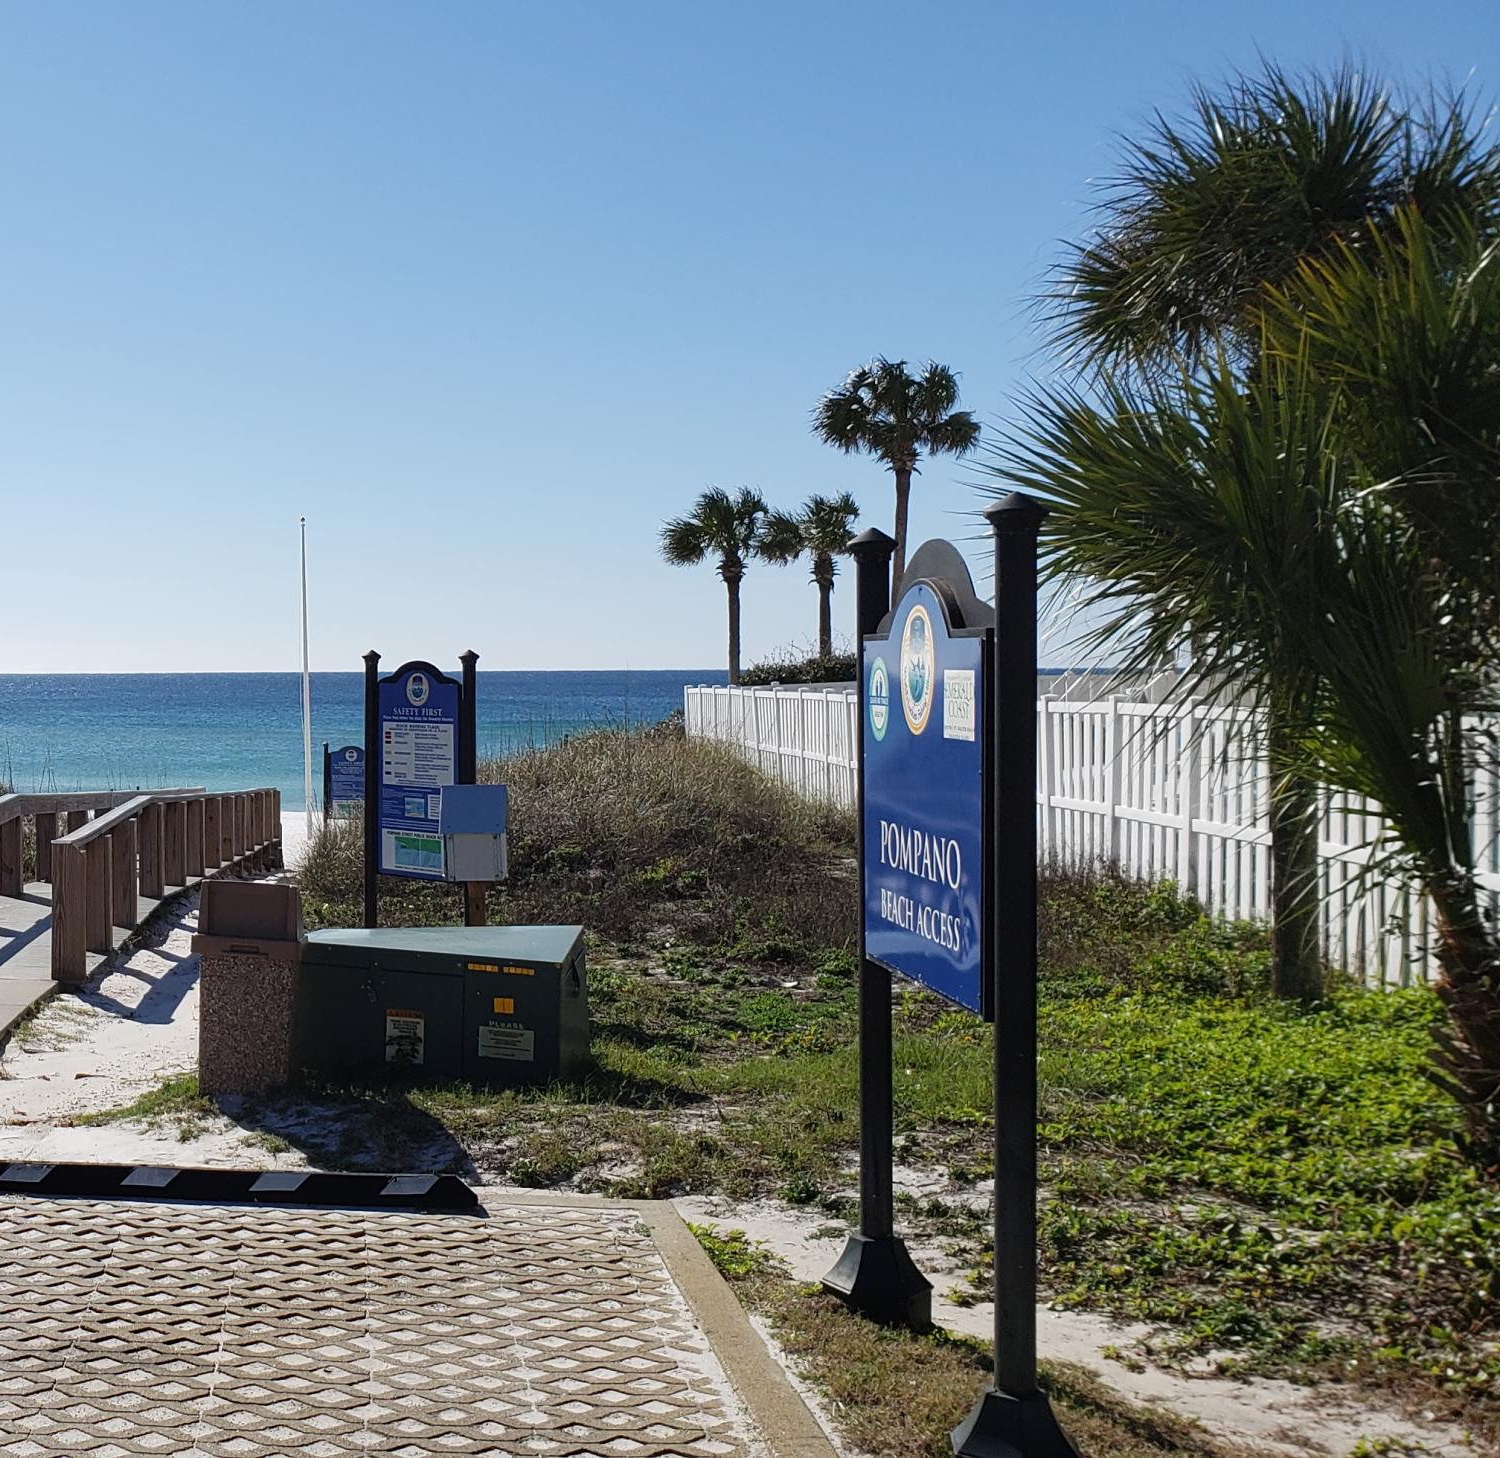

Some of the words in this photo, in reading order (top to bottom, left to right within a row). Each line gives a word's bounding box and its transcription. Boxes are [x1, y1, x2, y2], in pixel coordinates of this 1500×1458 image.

[393, 706, 420, 716] SAFETY
[421, 708, 443, 717] FIRST
[880, 820, 961, 889] POMPANO
[880, 888, 914, 932] BEACH
[916, 903, 961, 952] ACCESS
